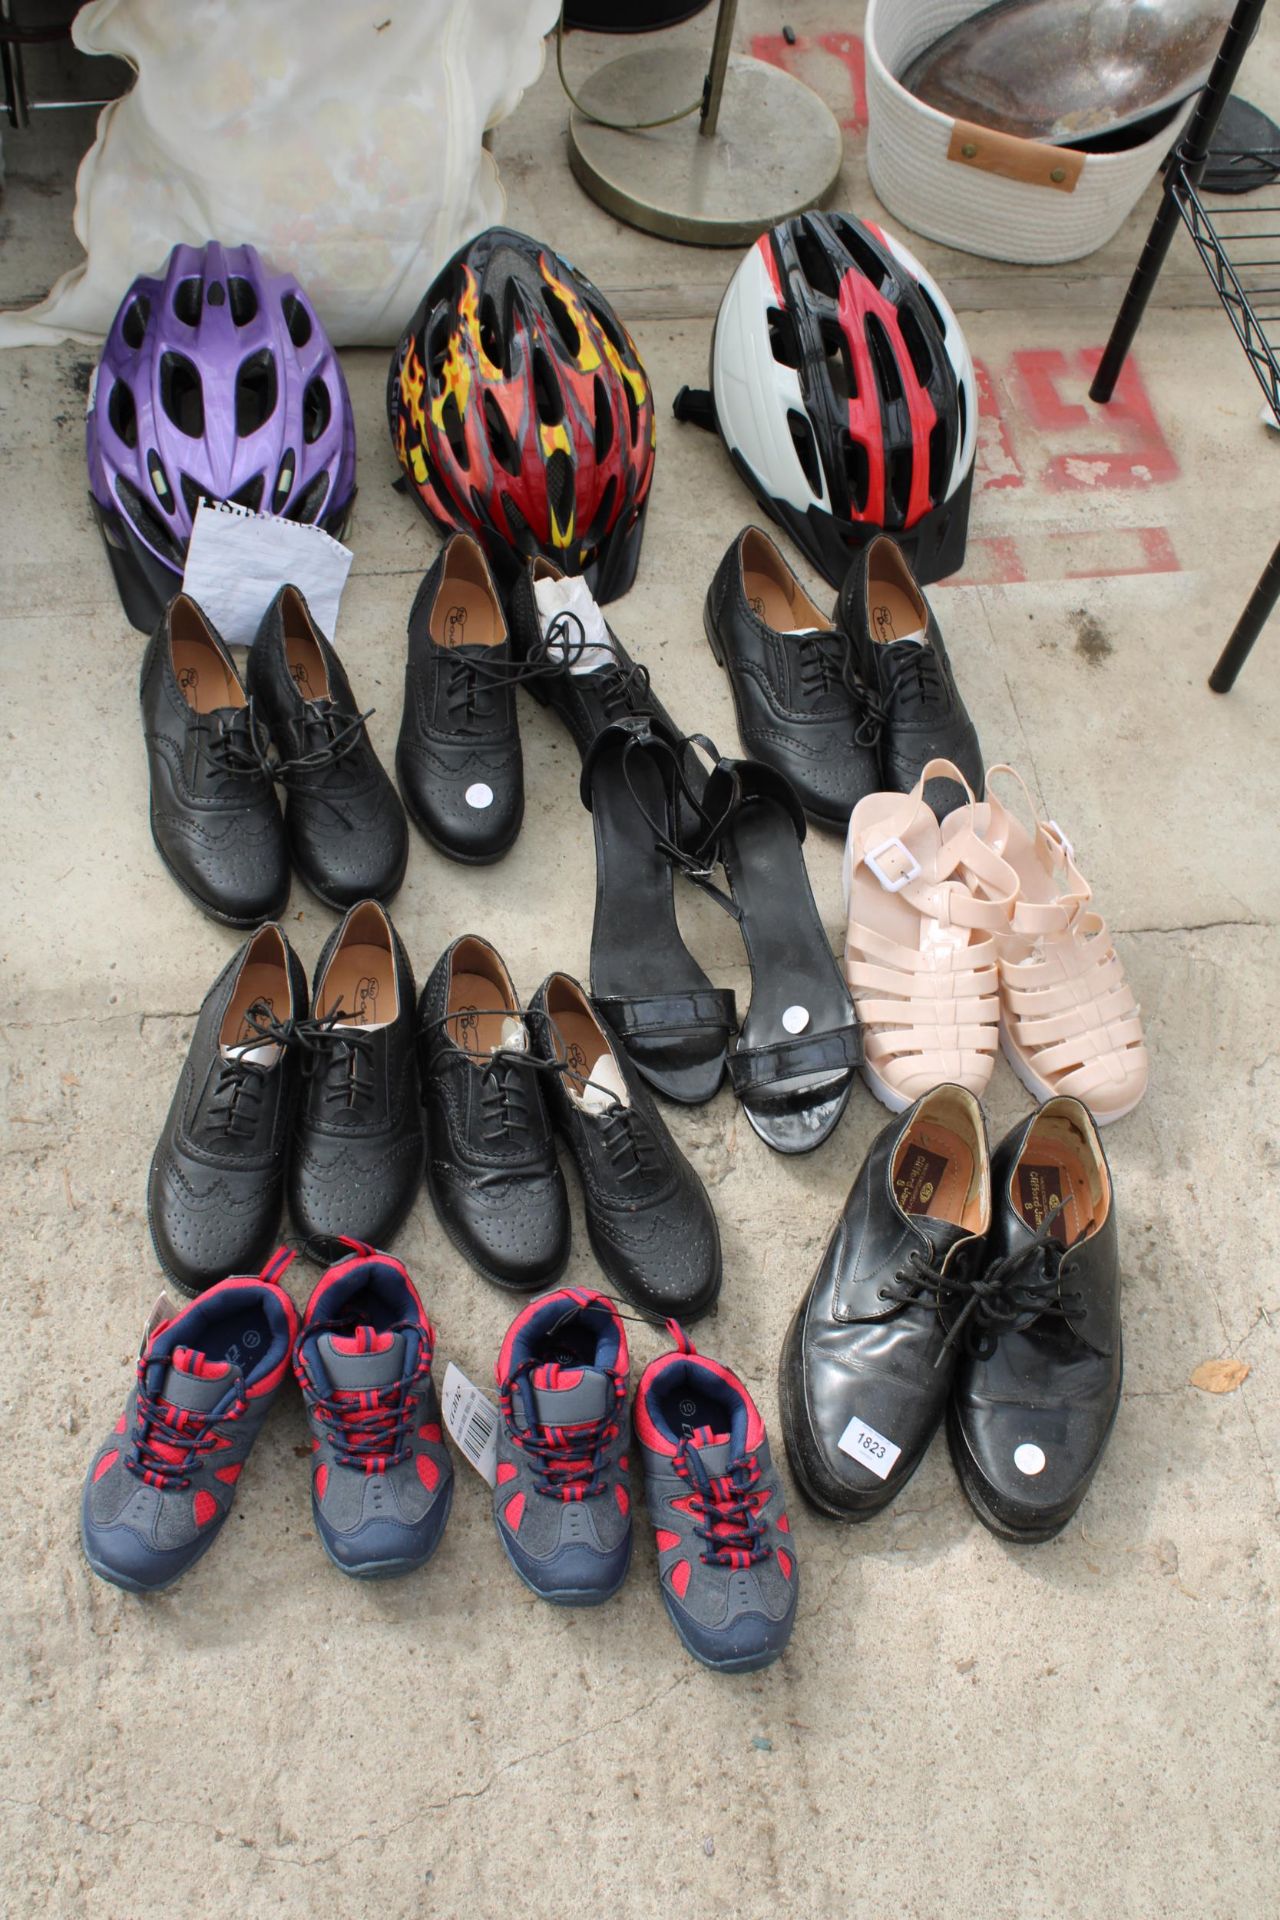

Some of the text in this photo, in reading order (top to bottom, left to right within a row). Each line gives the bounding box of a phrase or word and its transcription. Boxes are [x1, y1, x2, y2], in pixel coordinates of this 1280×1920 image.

[896, 1179, 906, 1187] 8
[1030, 1171, 1041, 1207] Clifford
[1024, 1202, 1034, 1210] 8
[857, 1432, 886, 1459] 1823
